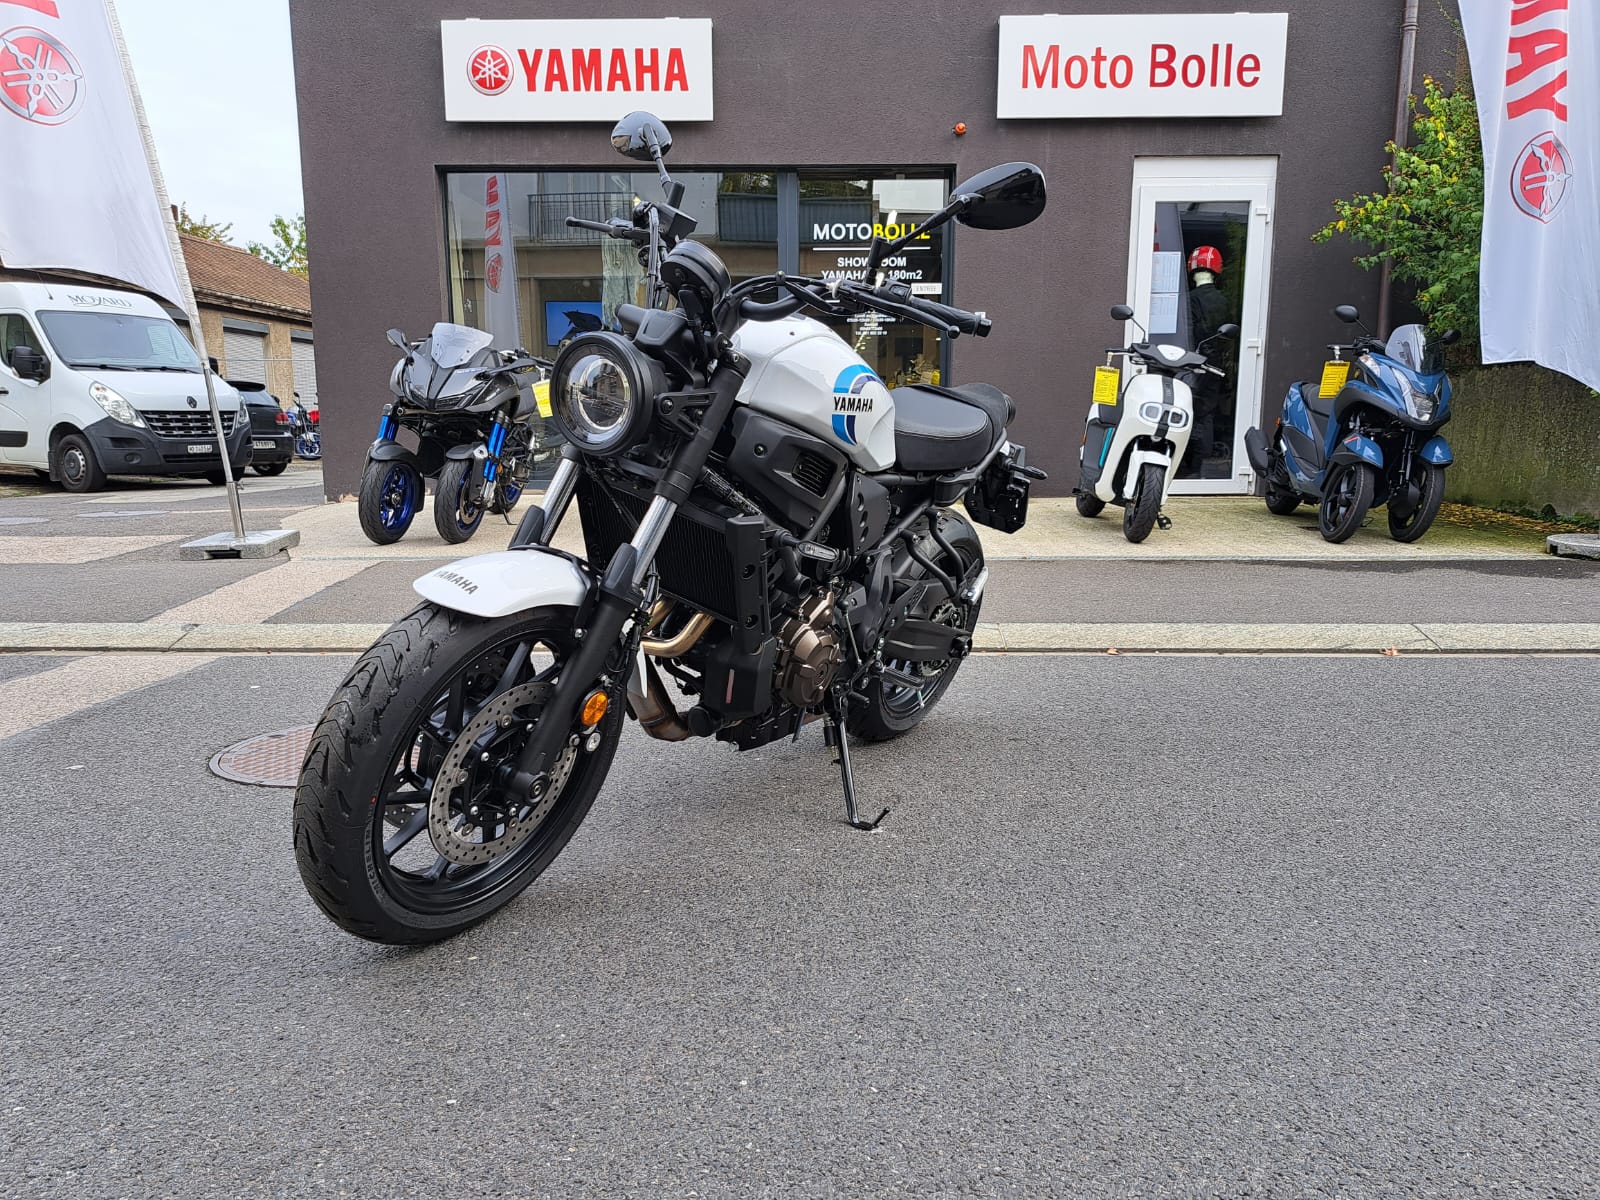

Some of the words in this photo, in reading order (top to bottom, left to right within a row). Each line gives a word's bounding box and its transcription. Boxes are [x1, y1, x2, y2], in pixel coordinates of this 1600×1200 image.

[517, 47, 689, 92] YAMAHA
[1021, 44, 1134, 89] Moto
[1149, 43, 1261, 88] Bolle
[837, 257, 907, 267] SHOWOOM
[833, 396, 873, 412] YAMAHA
[432, 570, 479, 595] YAMAHA
